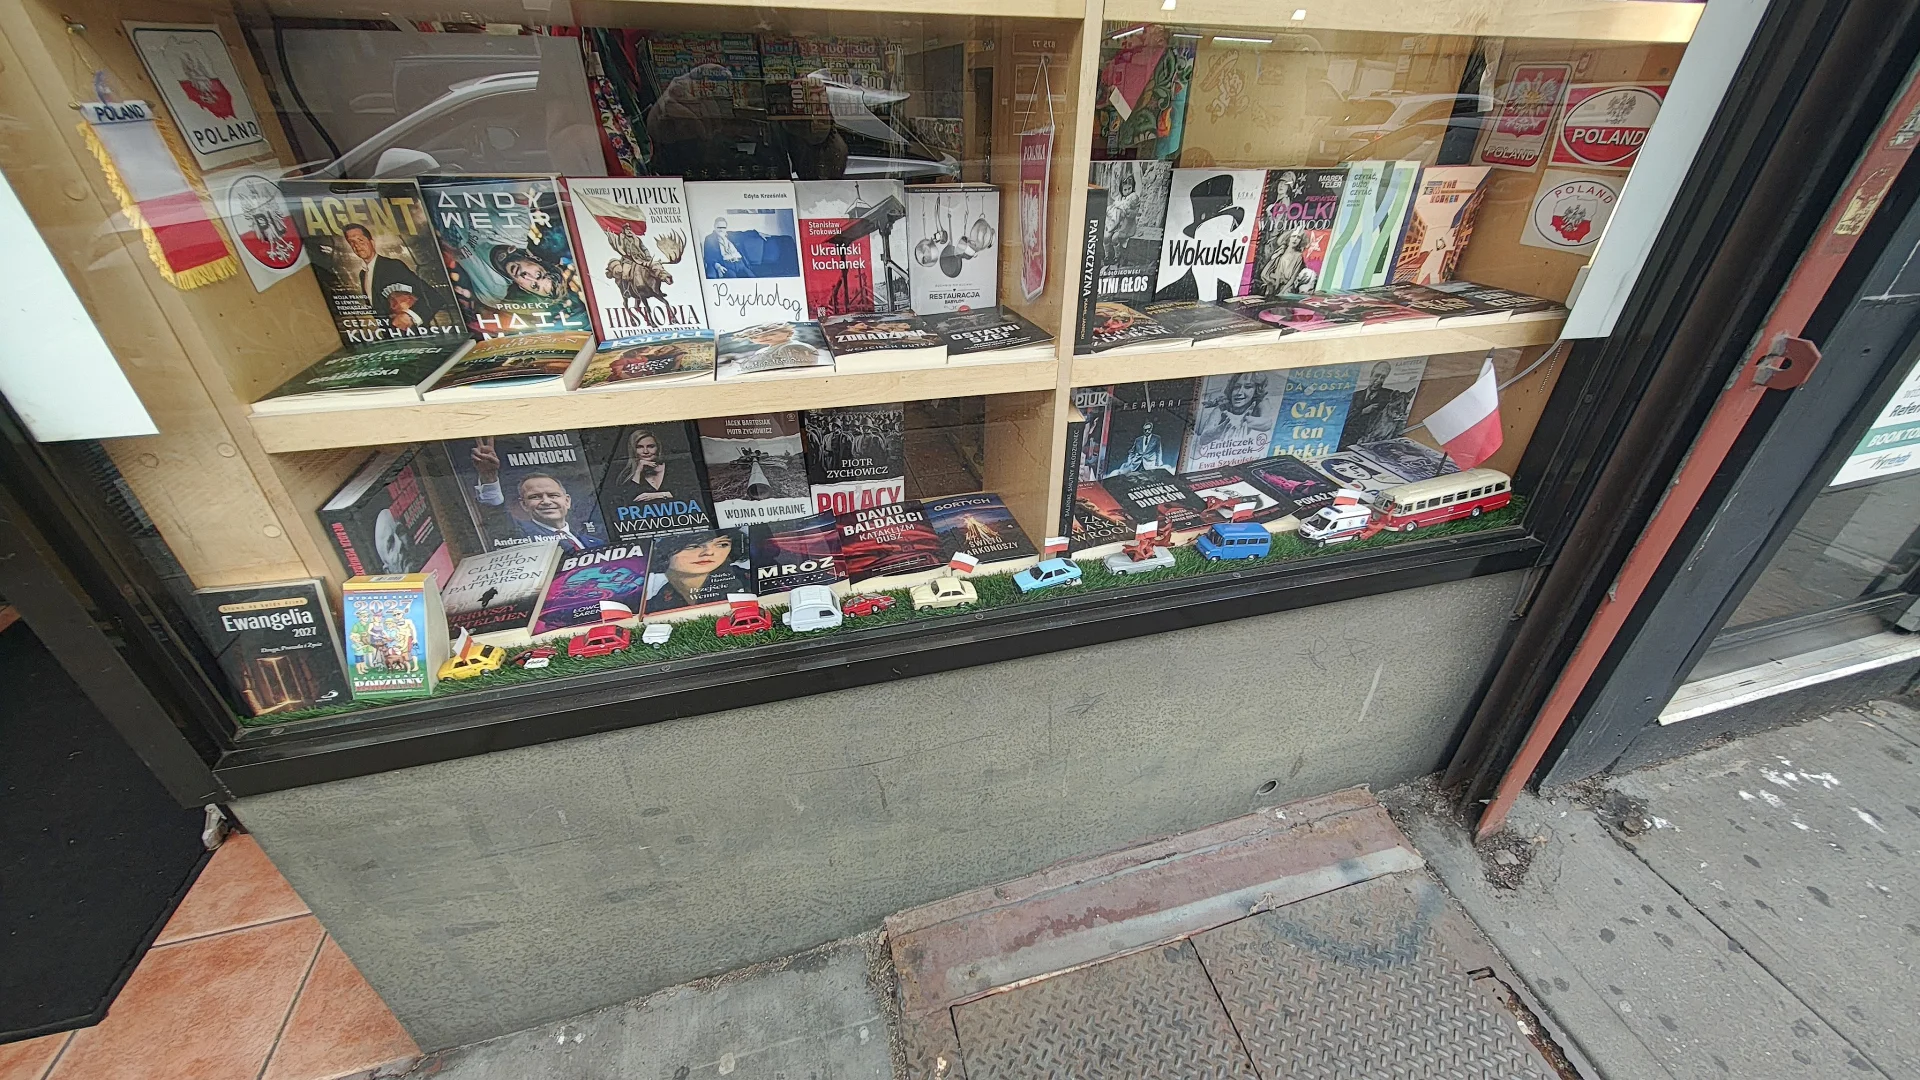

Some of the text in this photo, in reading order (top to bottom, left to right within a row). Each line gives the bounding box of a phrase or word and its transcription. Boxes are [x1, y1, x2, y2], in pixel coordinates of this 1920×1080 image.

[95, 103, 146, 121] POLAND
[193, 121, 259, 147] POLAND
[1567, 128, 1646, 146] POLAND
[1486, 145, 1535, 161] POLAND
[438, 190, 543, 208] ANDY
[612, 187, 680, 204] PILIPIUK
[1554, 185, 1616, 204] POLAND
[301, 197, 418, 236] AGENT
[1272, 201, 1336, 221] POLKI
[440, 212, 552, 229] WEIR
[808, 221, 840, 229] Stanisław
[809, 228, 842, 236] Srokowski
[811, 243, 862, 257] Ukraiński
[1083, 219, 1099, 297] PAŃSZCZYZNA
[1169, 235, 1249, 267] Wokulski
[812, 259, 866, 271] kochanek
[1120, 275, 1149, 293] GŁOS
[713, 282, 803, 321] Psycholog
[929, 292, 980, 300] RESTAURACJA
[496, 302, 550, 310] PROJEKT
[343, 318, 390, 328] CEZARY
[476, 311, 583, 329] HAIL
[605, 304, 701, 328] HISTORIA
[950, 324, 1021, 341] OSTATNI
[969, 331, 1011, 344] SZEF
[1291, 402, 1337, 419] Cały
[529, 434, 572, 449] KAROL
[1292, 428, 1323, 439] ten
[1866, 431, 1903, 448] BOOK
[1210, 438, 1254, 450] Entliczek
[507, 450, 577, 467] NAWROCKI
[1206, 446, 1254, 461] mętliczek
[842, 459, 873, 468] PIOTR
[1198, 462, 1215, 470] Ewa
[826, 466, 889, 479] ZYCHOWICZ
[816, 486, 902, 515] POLACY
[1128, 484, 1179, 500] ADWOKAT
[1136, 492, 1187, 508] DIABŁÓW
[617, 500, 702, 520] PRAWDA
[725, 504, 806, 519] WOJNA O UKRAINĘ
[934, 498, 990, 511] GORTYCH
[855, 505, 904, 522] DAVID
[614, 512, 710, 533] WYZWOLONA
[843, 511, 924, 537] BALDACCI
[494, 533, 569, 547] Andrzej Nowak
[859, 524, 915, 541] KATAKLIZM
[876, 533, 903, 543] DUSZ
[467, 555, 538, 575] CLINTON
[489, 552, 523, 564] BILL
[561, 545, 644, 572] BONDA
[471, 566, 525, 582] JAMES
[758, 555, 835, 580] MRÓZ
[448, 570, 543, 595] PATTERSON
[354, 599, 415, 616] 2027
[446, 604, 518, 624] IERWSZY
[573, 604, 600, 614] ŁOWC
[221, 608, 314, 632] Ewangelia
[292, 626, 317, 638] 2027
